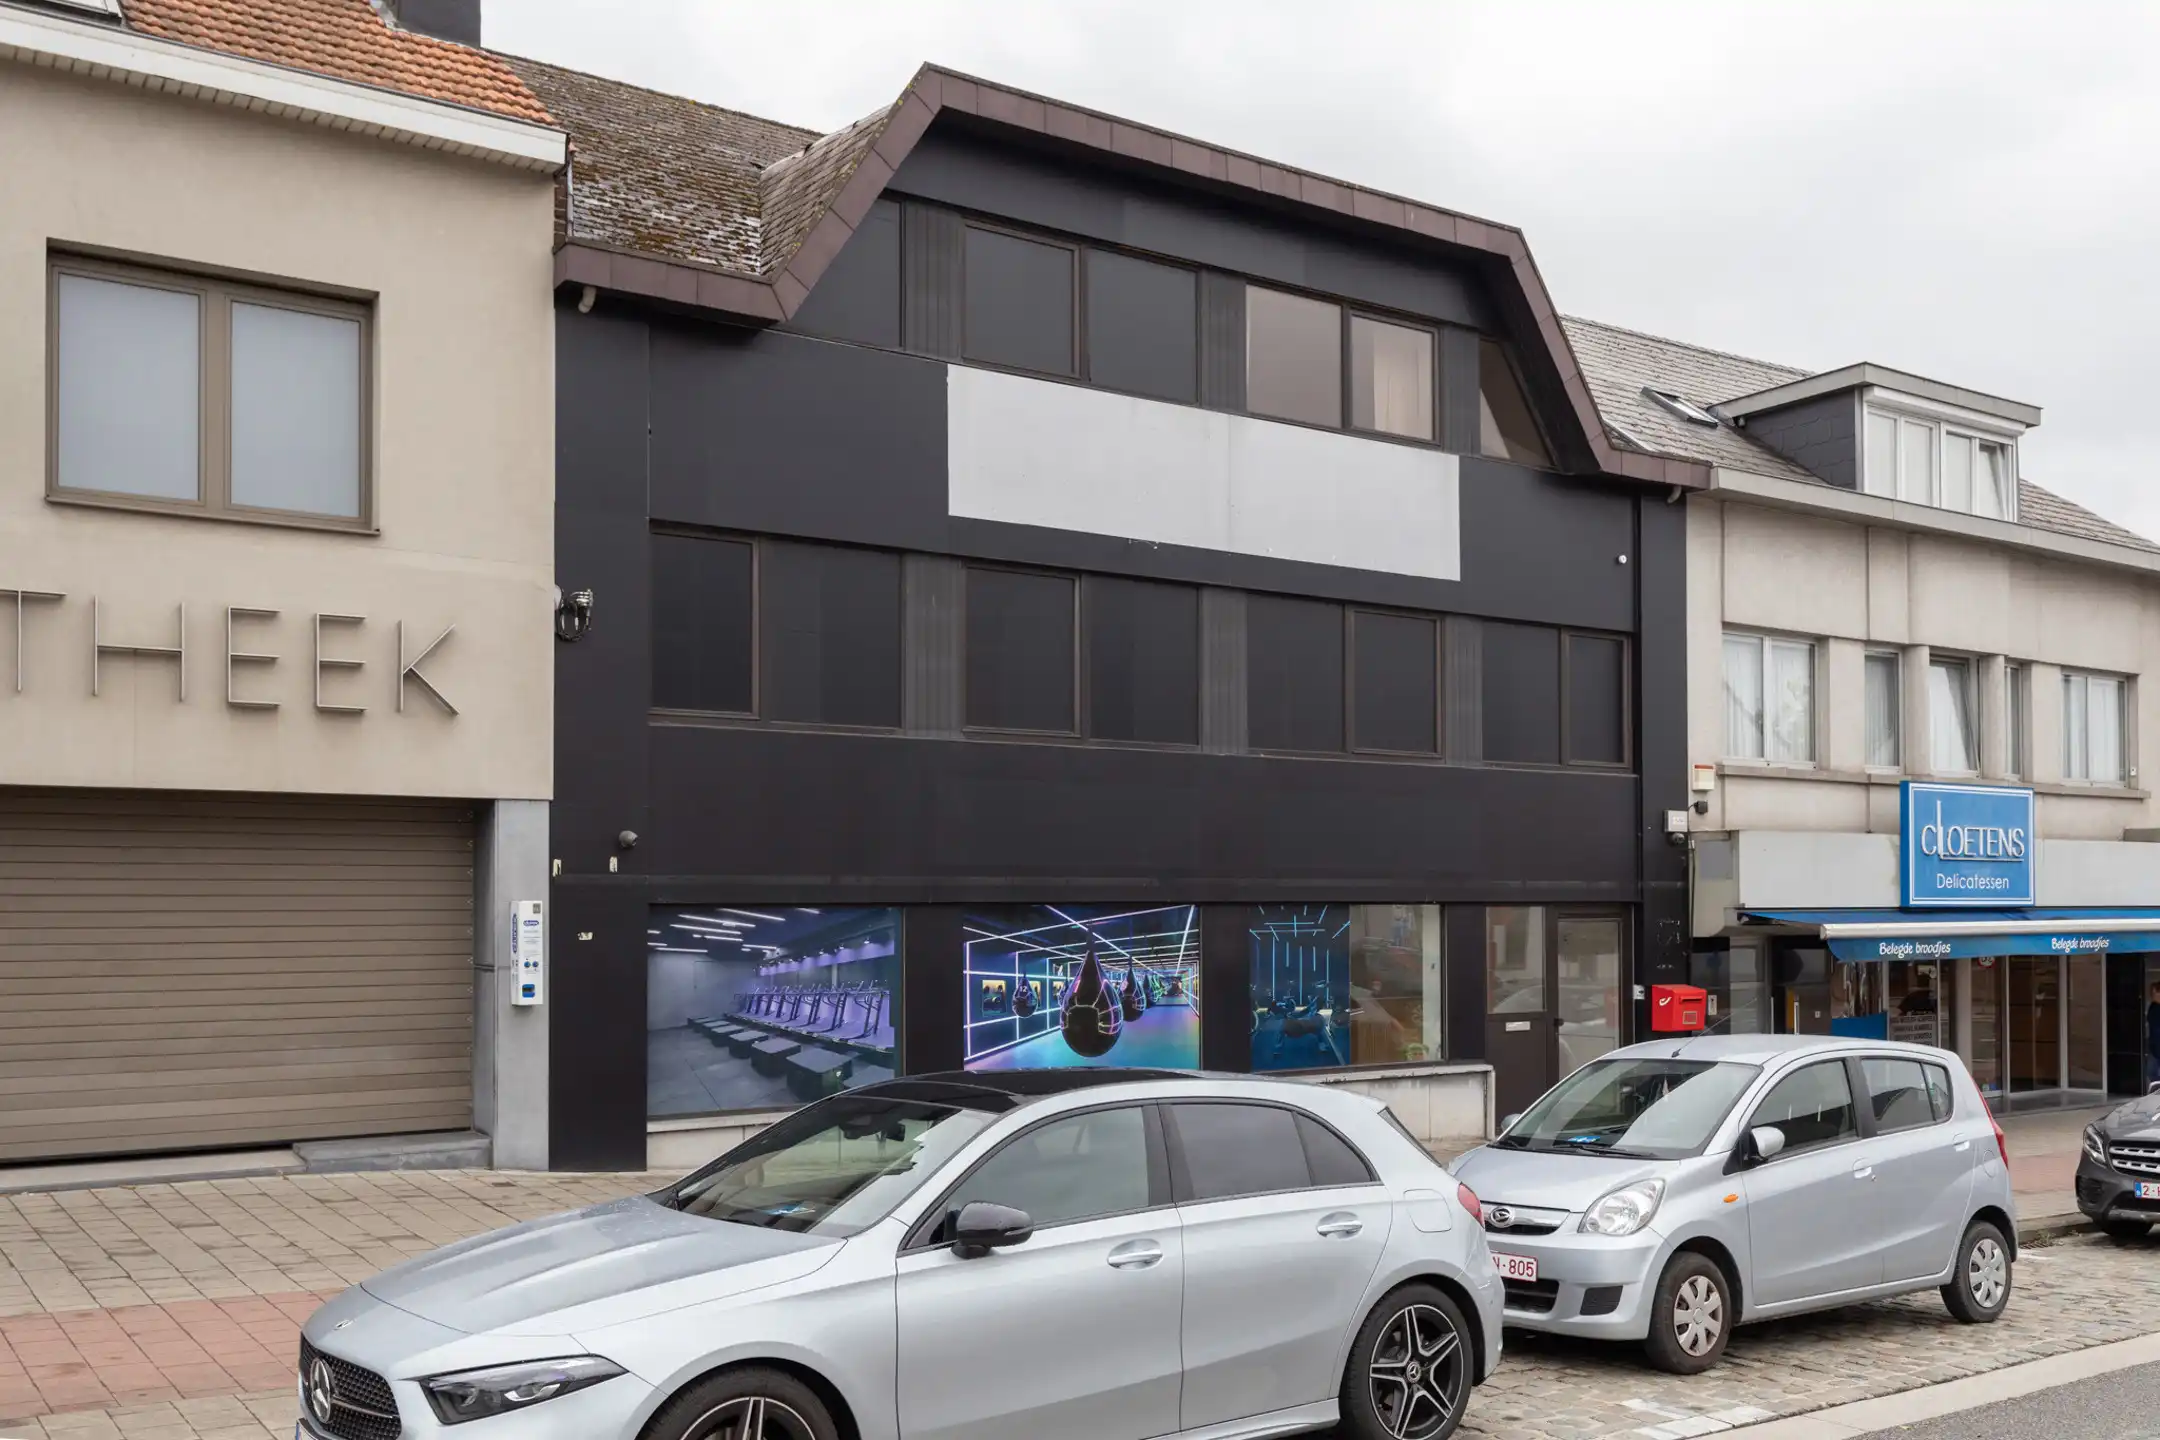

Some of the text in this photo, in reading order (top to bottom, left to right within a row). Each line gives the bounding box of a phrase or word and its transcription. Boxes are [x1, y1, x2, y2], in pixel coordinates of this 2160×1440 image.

[1921, 800, 2025, 860] CLOETENS
[1936, 872, 2010, 890] Delicatessen
[1879, 941, 1951, 958] Belegde broodjes
[2051, 936, 2109, 953] Belegde broodjes
